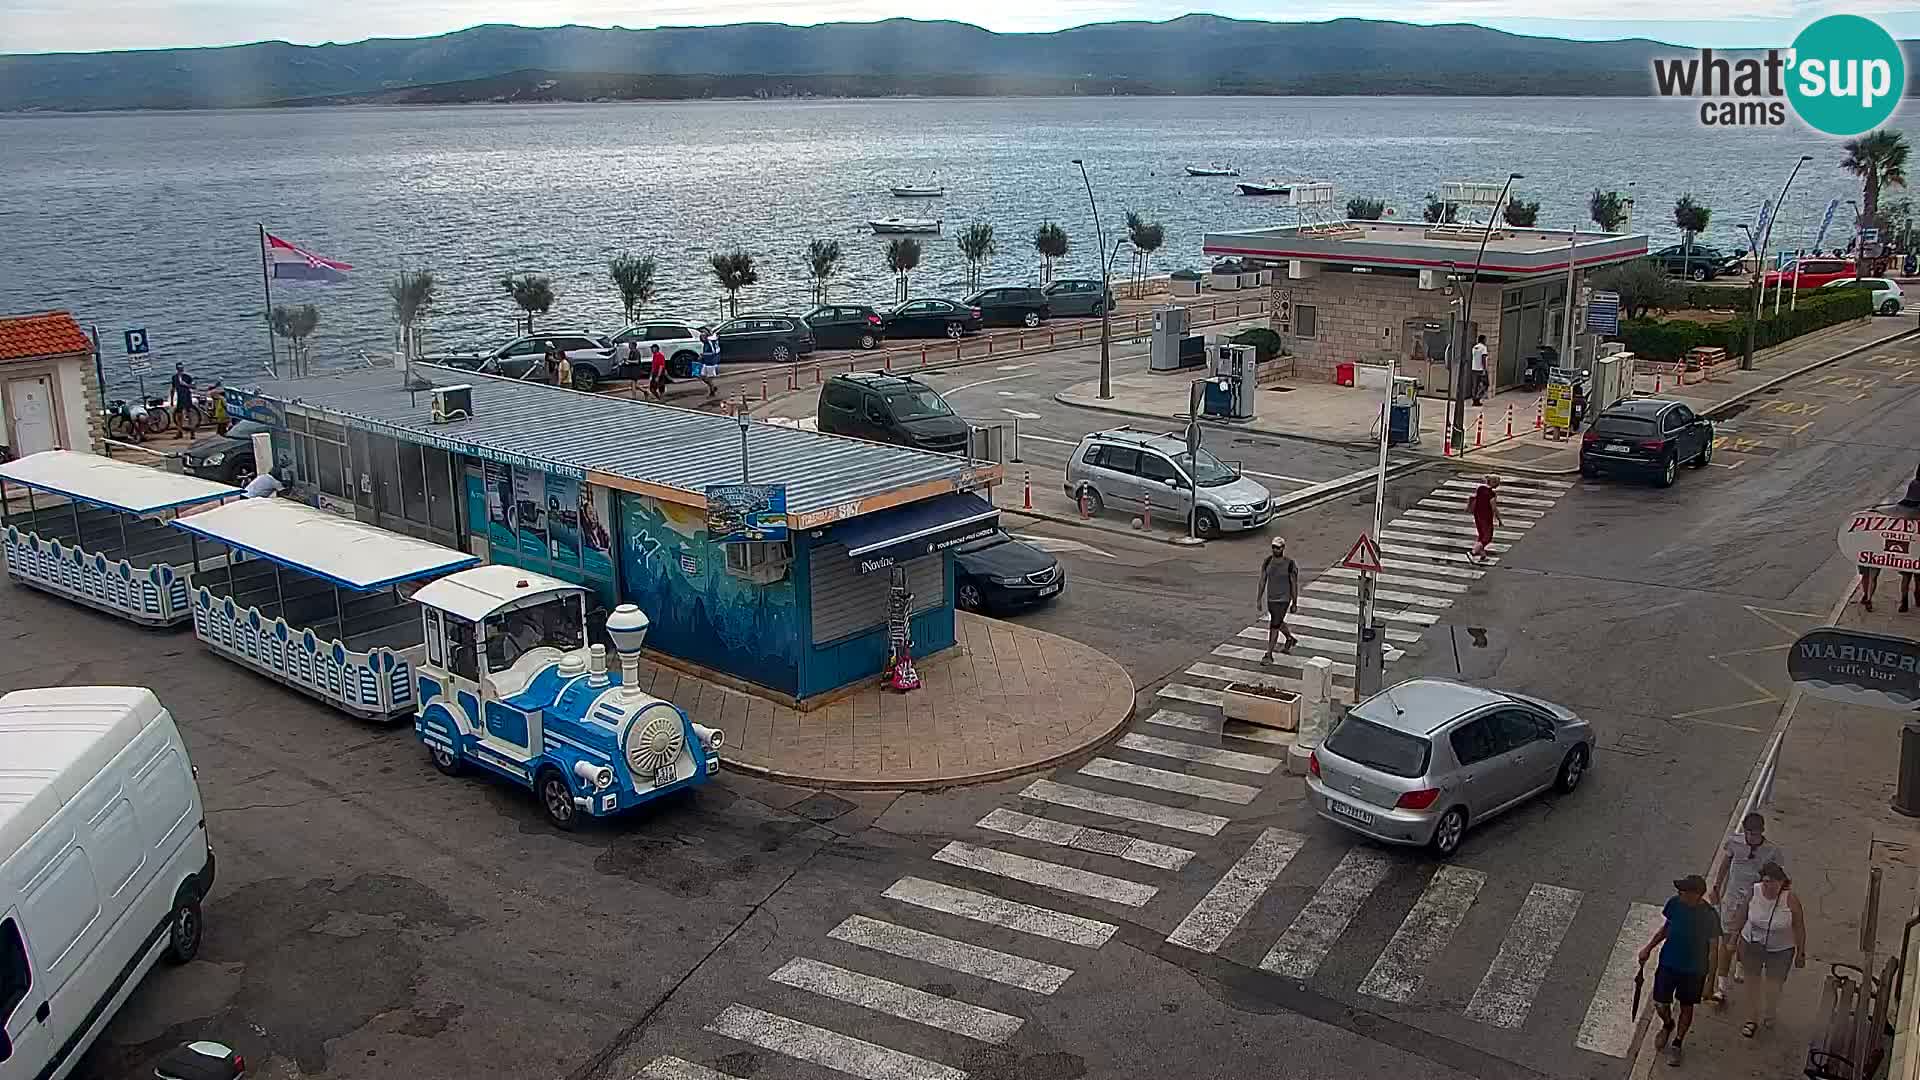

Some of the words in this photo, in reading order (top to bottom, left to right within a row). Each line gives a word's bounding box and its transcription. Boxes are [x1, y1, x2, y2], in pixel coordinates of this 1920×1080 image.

[130, 333, 142, 351] P
[478, 447, 493, 459] BUS
[494, 451, 526, 467] STATION
[528, 458, 554, 473] TICKET
[555, 465, 583, 480] OFFICE
[1881, 532, 1916, 542] GRILL
[1800, 643, 1920, 673] MARINER
[1870, 667, 1896, 681] bar
